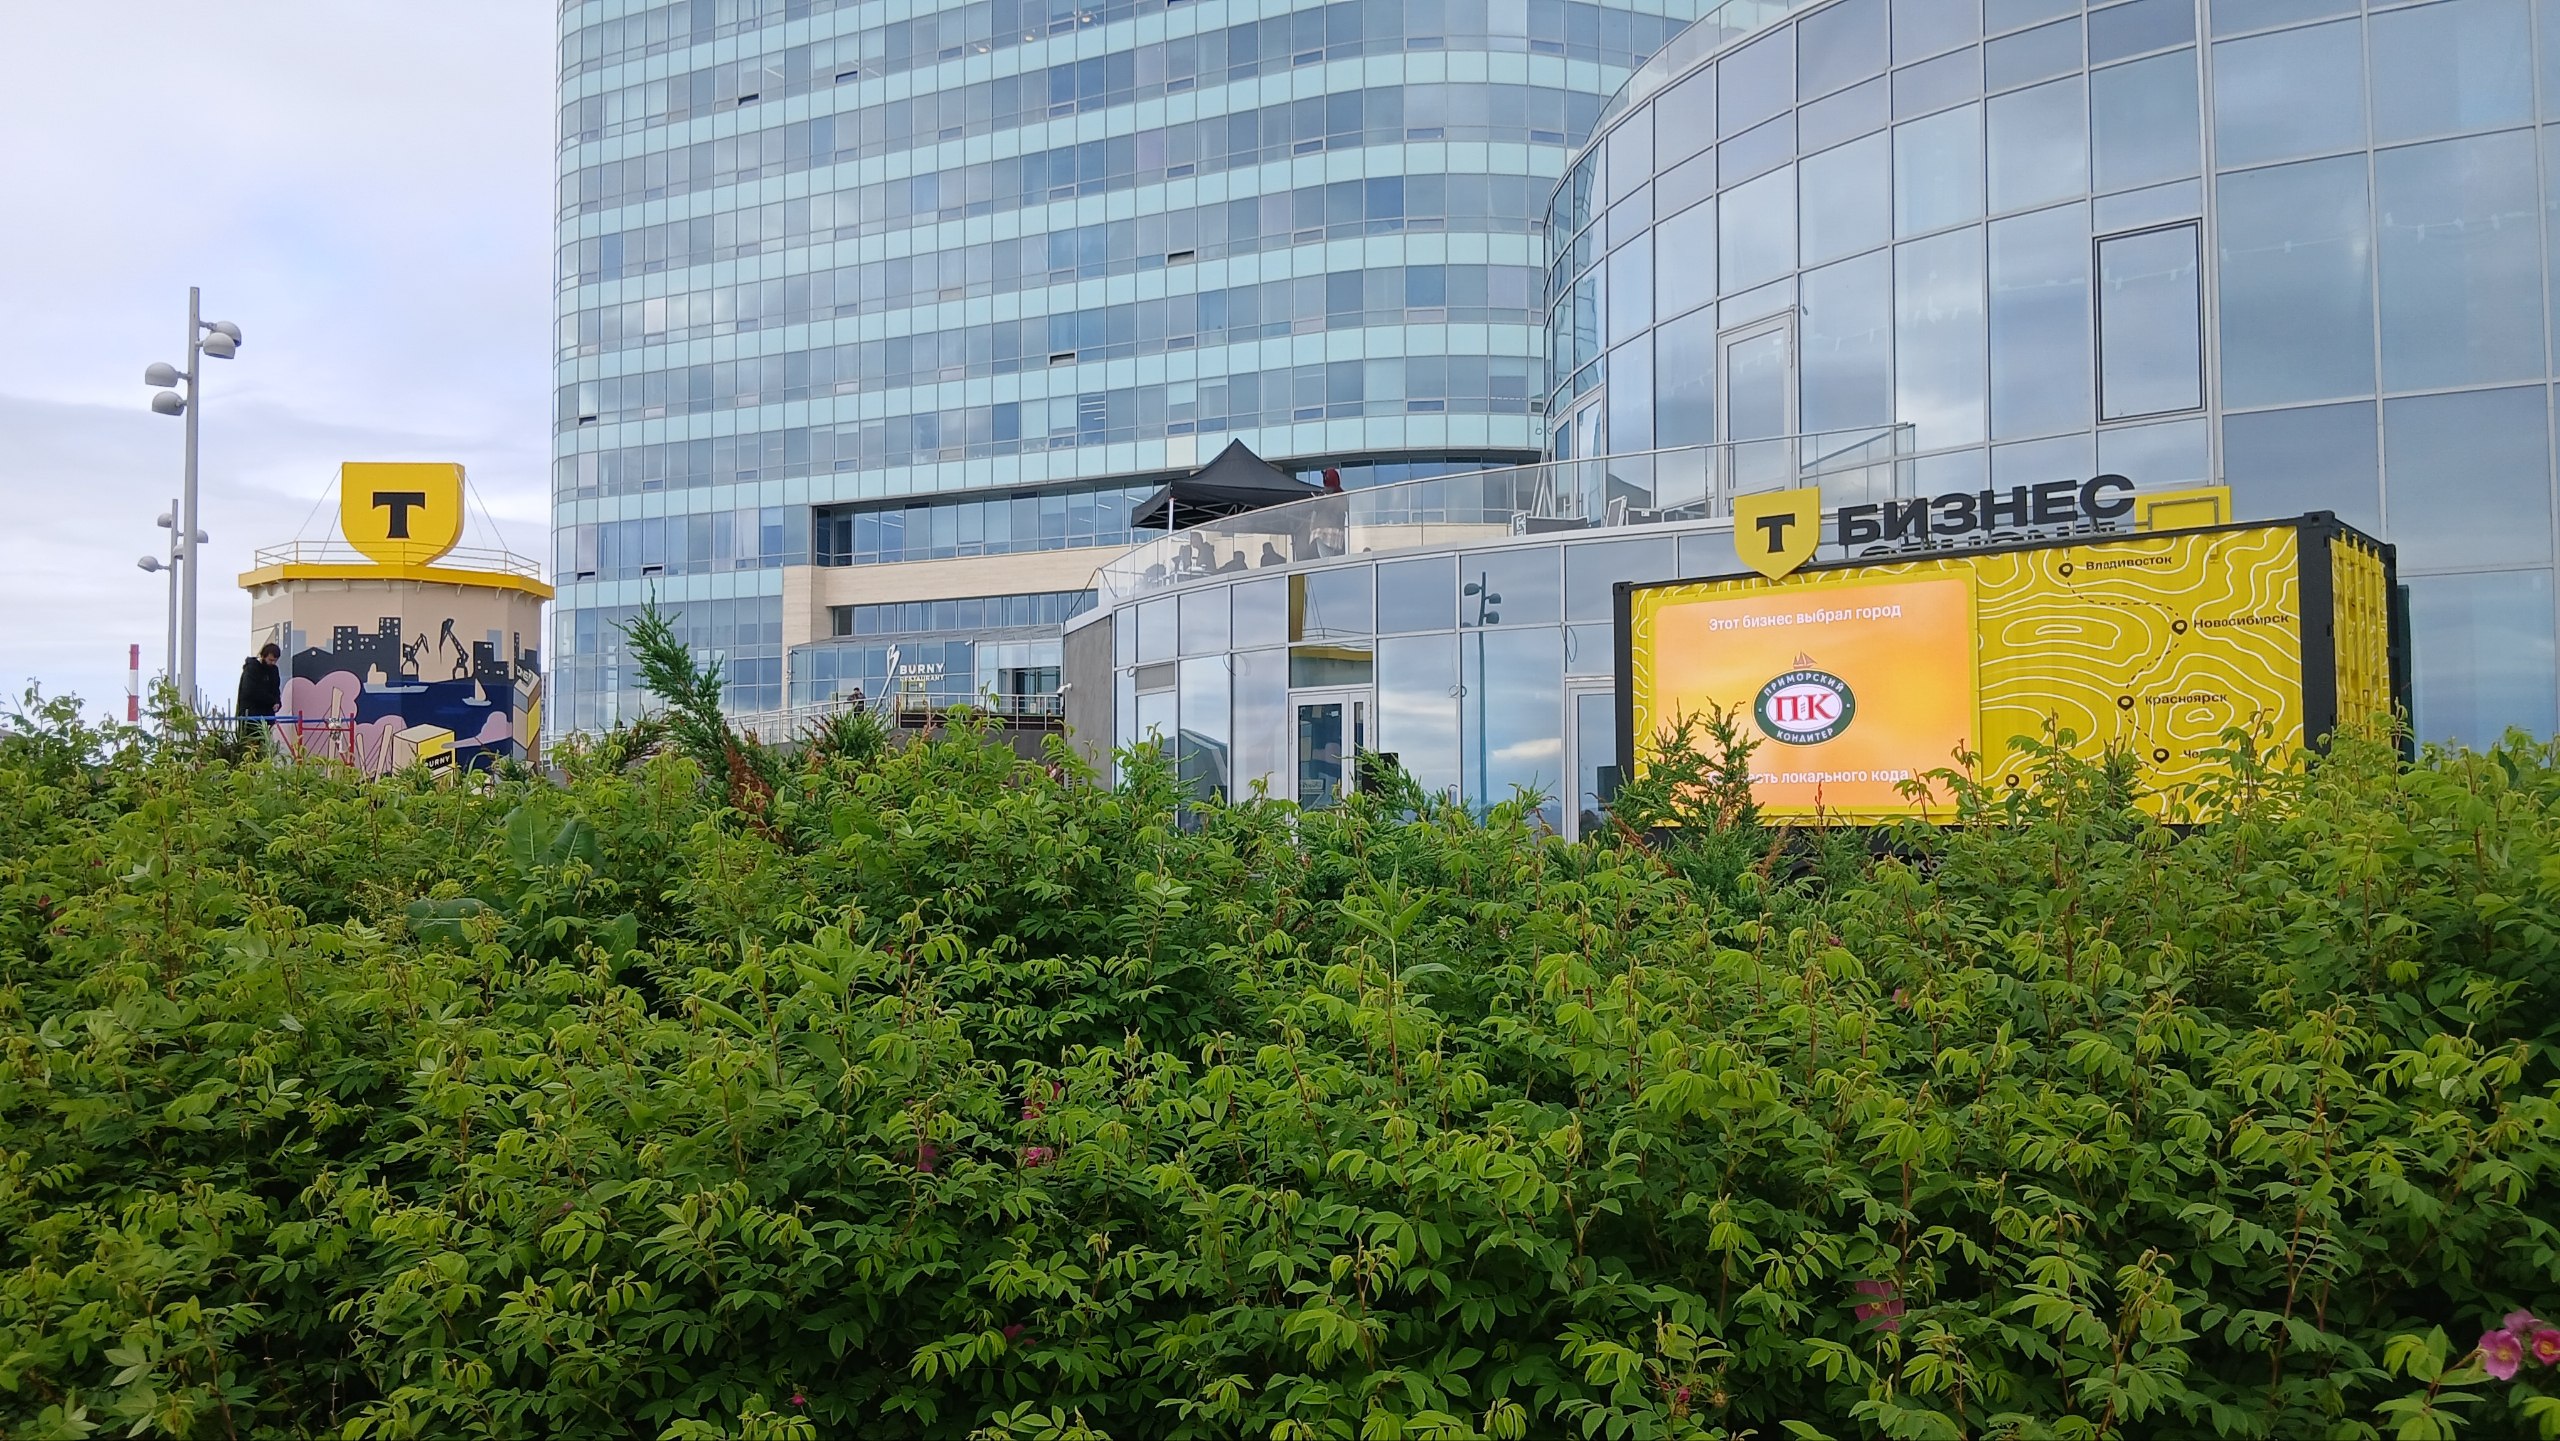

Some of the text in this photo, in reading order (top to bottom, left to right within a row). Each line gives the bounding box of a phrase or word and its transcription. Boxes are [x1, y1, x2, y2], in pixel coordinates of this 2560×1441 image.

[1838, 474, 2136, 546] БИЗНЕС
[2085, 555, 2173, 570] Владивосток
[1708, 604, 1902, 631] Этот бизнес выбрал город
[2193, 615, 2290, 629] Новосибирск
[900, 663, 945, 675] BURNY
[1763, 672, 1845, 697] ПРИМОРСКИЙ
[2145, 692, 2228, 706] Красноярск
[1773, 693, 1836, 722] ПК
[1776, 727, 1834, 743] КОНДИТЕР
[1780, 770, 1867, 785] локального
[1871, 768, 1909, 783] кода
